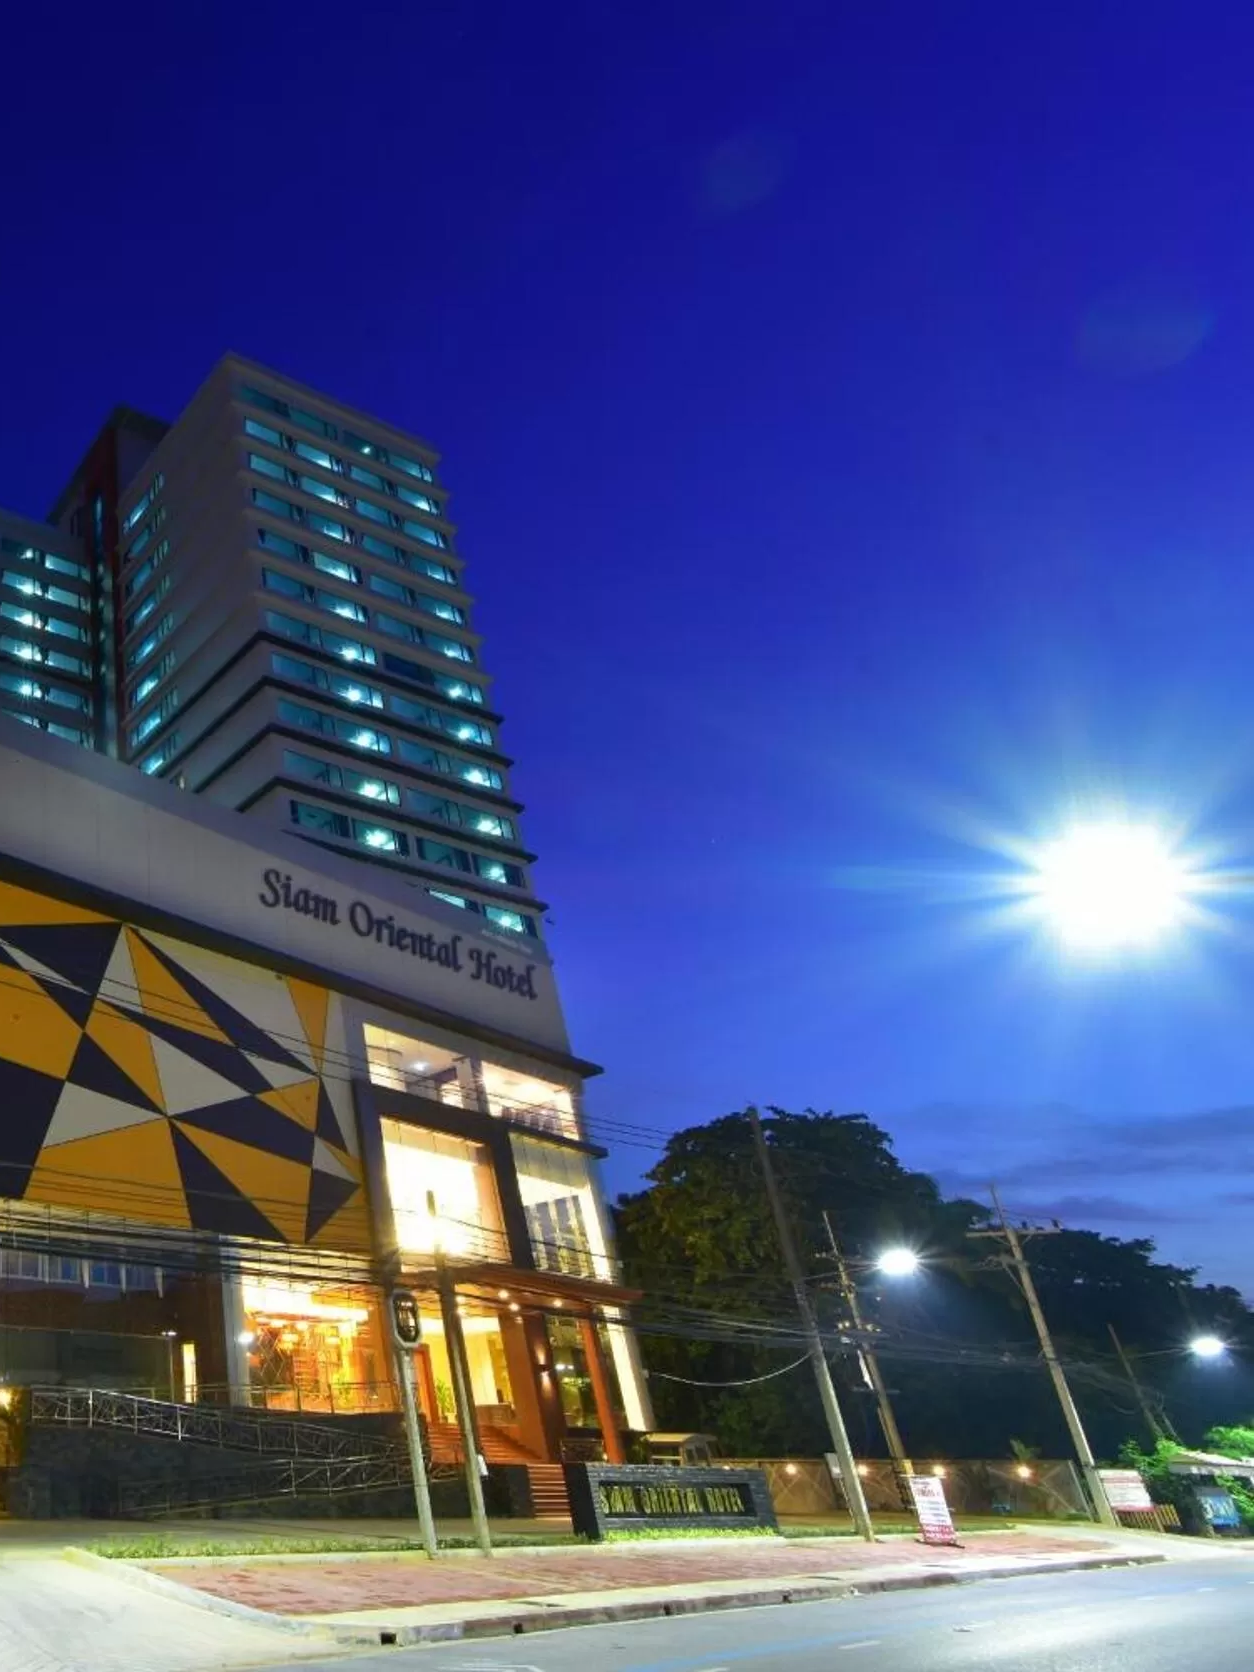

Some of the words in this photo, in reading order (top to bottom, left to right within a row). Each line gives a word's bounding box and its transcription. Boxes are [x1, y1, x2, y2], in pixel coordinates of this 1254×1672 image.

[259, 868, 341, 925] Siam
[349, 901, 463, 973] Oriental
[469, 948, 538, 1000] Hotel
